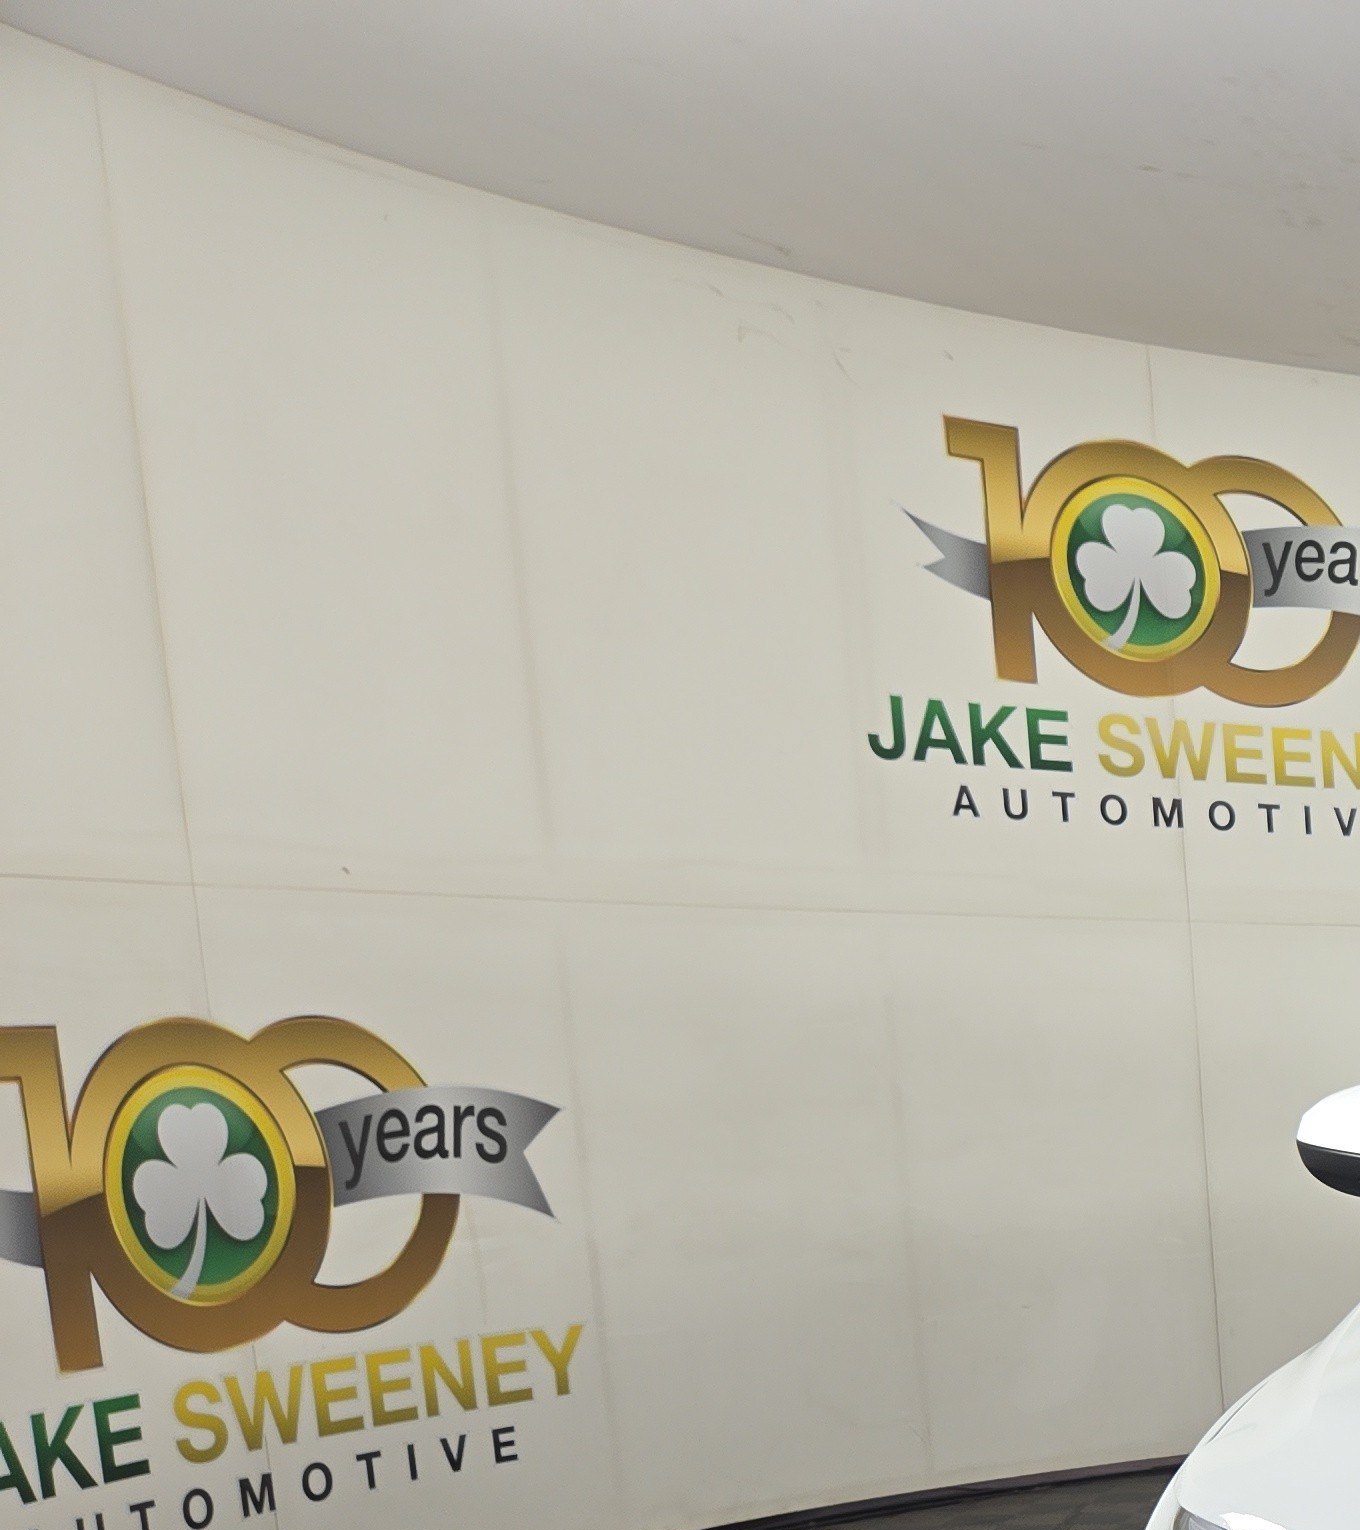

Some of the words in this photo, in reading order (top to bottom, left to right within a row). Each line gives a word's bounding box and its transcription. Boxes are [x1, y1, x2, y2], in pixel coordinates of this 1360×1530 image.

[867, 695, 1073, 773] JAKE
[338, 1103, 508, 1190] years
[172, 1323, 585, 1464] SWEENEY
